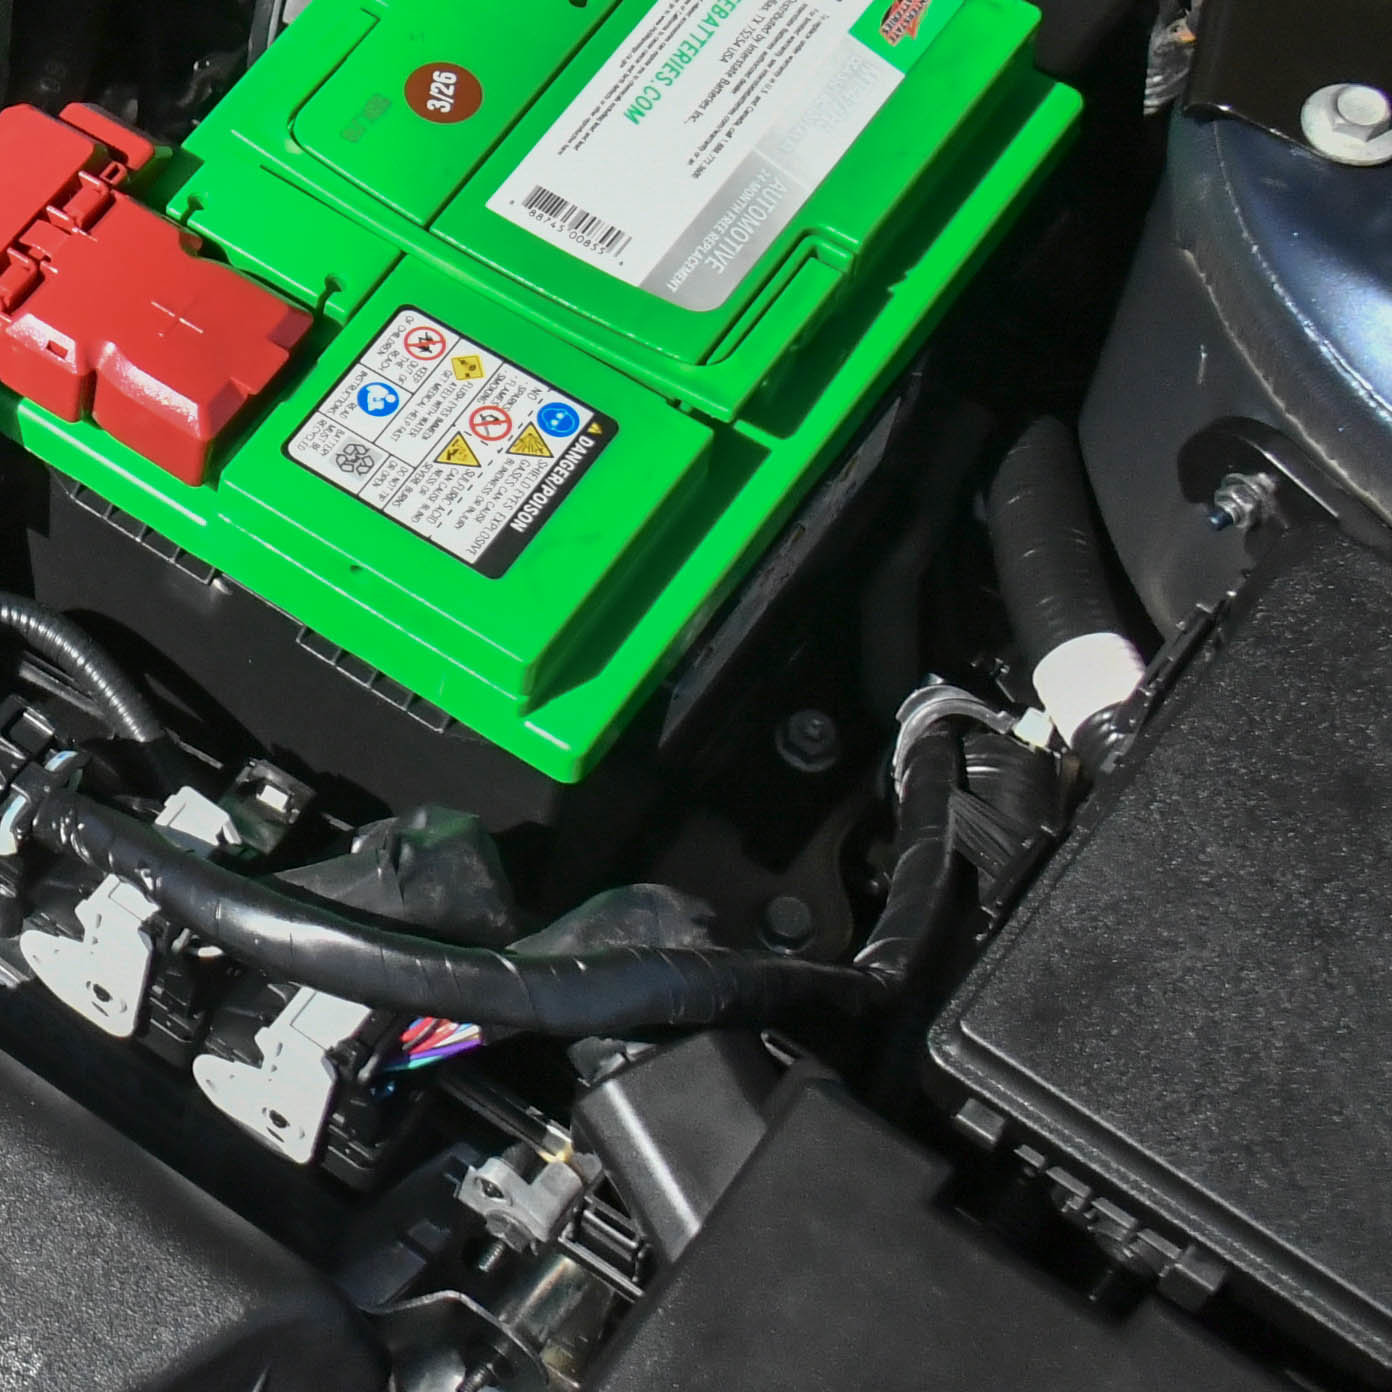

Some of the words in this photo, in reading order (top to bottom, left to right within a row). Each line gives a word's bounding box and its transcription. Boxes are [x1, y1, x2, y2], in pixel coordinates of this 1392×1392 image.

[751, 13, 765, 25] TX
[730, 23, 757, 48] 75254
[750, 31, 767, 44] by
[717, 45, 738, 64] USA
[723, 42, 759, 79] Interstate
[427, 71, 457, 113] 3/26
[697, 76, 731, 111] Batteries
[702, 175, 791, 274] AUTOMOTIVE
[711, 210, 737, 234] FREE
[568, 230, 606, 255] 00855
[663, 229, 720, 293] REPLACEMENT
[375, 323, 407, 357] CHILDREN
[376, 348, 401, 372] REACH
[394, 354, 410, 369] THE
[402, 359, 420, 375] OUT
[394, 373, 409, 385] OF
[326, 368, 368, 416] INSTRUCTIONS
[415, 381, 443, 409] MEDICAL
[452, 380, 474, 403] FLUSH
[525, 385, 543, 401] NO
[401, 408, 420, 427] HELP
[425, 399, 443, 417] WITH
[439, 400, 458, 418] EYES
[295, 417, 327, 452] RECYCLED
[315, 422, 336, 443] MUST
[317, 427, 345, 458] BATTERY
[388, 424, 407, 442] FAST
[309, 441, 321, 451] BE
[370, 468, 391, 489] OPEN
[409, 461, 433, 486] SEVERE
[442, 466, 459, 483] CAN
[479, 456, 515, 496] BLINDNESS
[503, 457, 532, 487] GASES
[508, 432, 595, 535] DANGER/POISON
[518, 457, 549, 490] SHIELD
[426, 480, 448, 503] CAUSE
[440, 467, 476, 507] SULFURIC
[491, 484, 508, 502] CAN
[472, 494, 485, 507] OR
[473, 500, 496, 524] CAUSE
[424, 503, 447, 526] ACID
[465, 510, 506, 557] EXPLOSIVE
